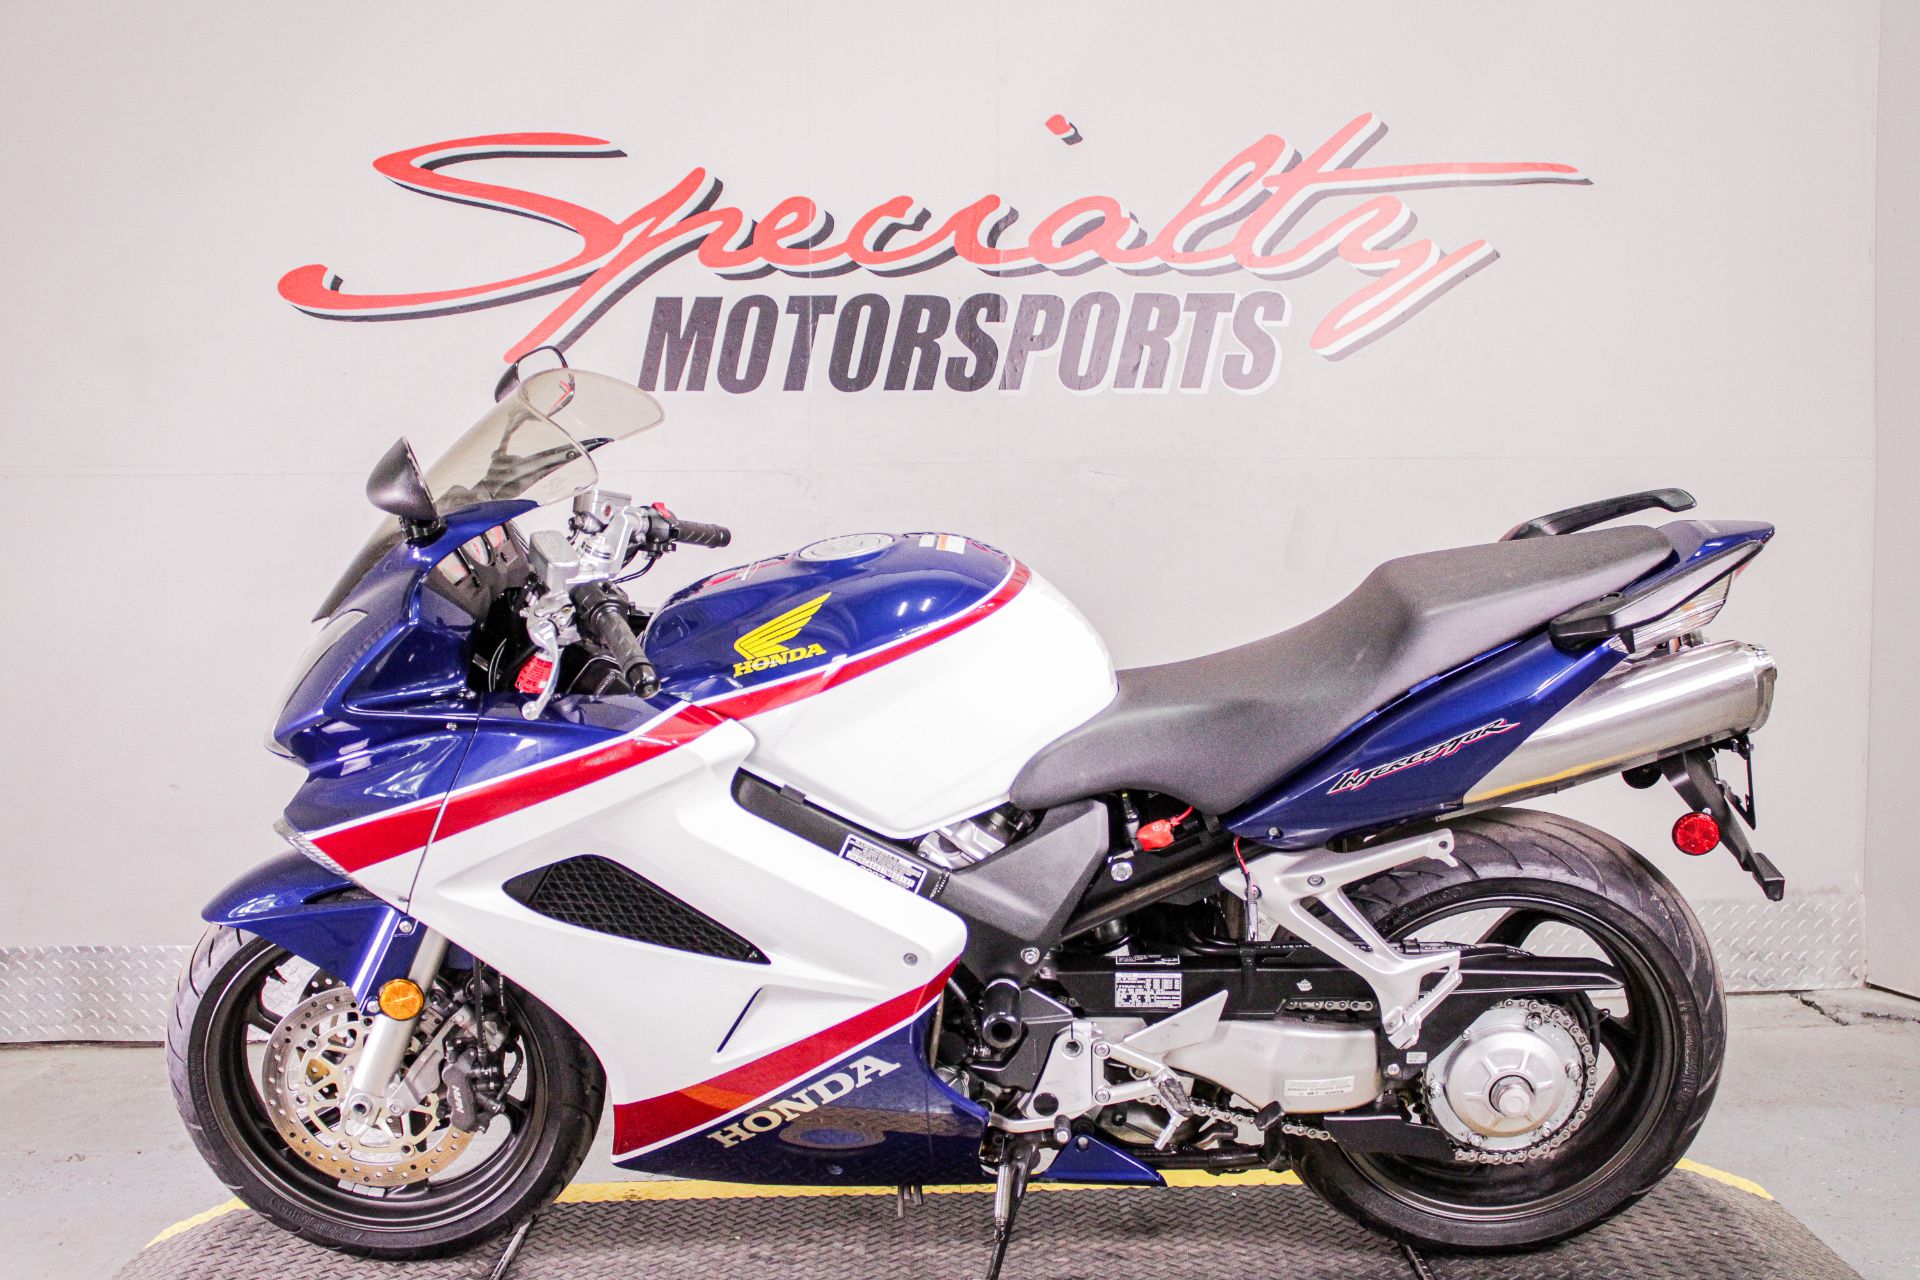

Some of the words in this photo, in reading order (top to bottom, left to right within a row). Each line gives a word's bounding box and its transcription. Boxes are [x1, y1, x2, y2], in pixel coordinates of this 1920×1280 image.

[278, 111, 1593, 362] Specialty
[640, 291, 1291, 395] MOTORSPORTS
[733, 643, 827, 678] HONDA
[1326, 717, 1521, 795] INTERCEPTOR
[707, 1055, 902, 1149] HONDA
